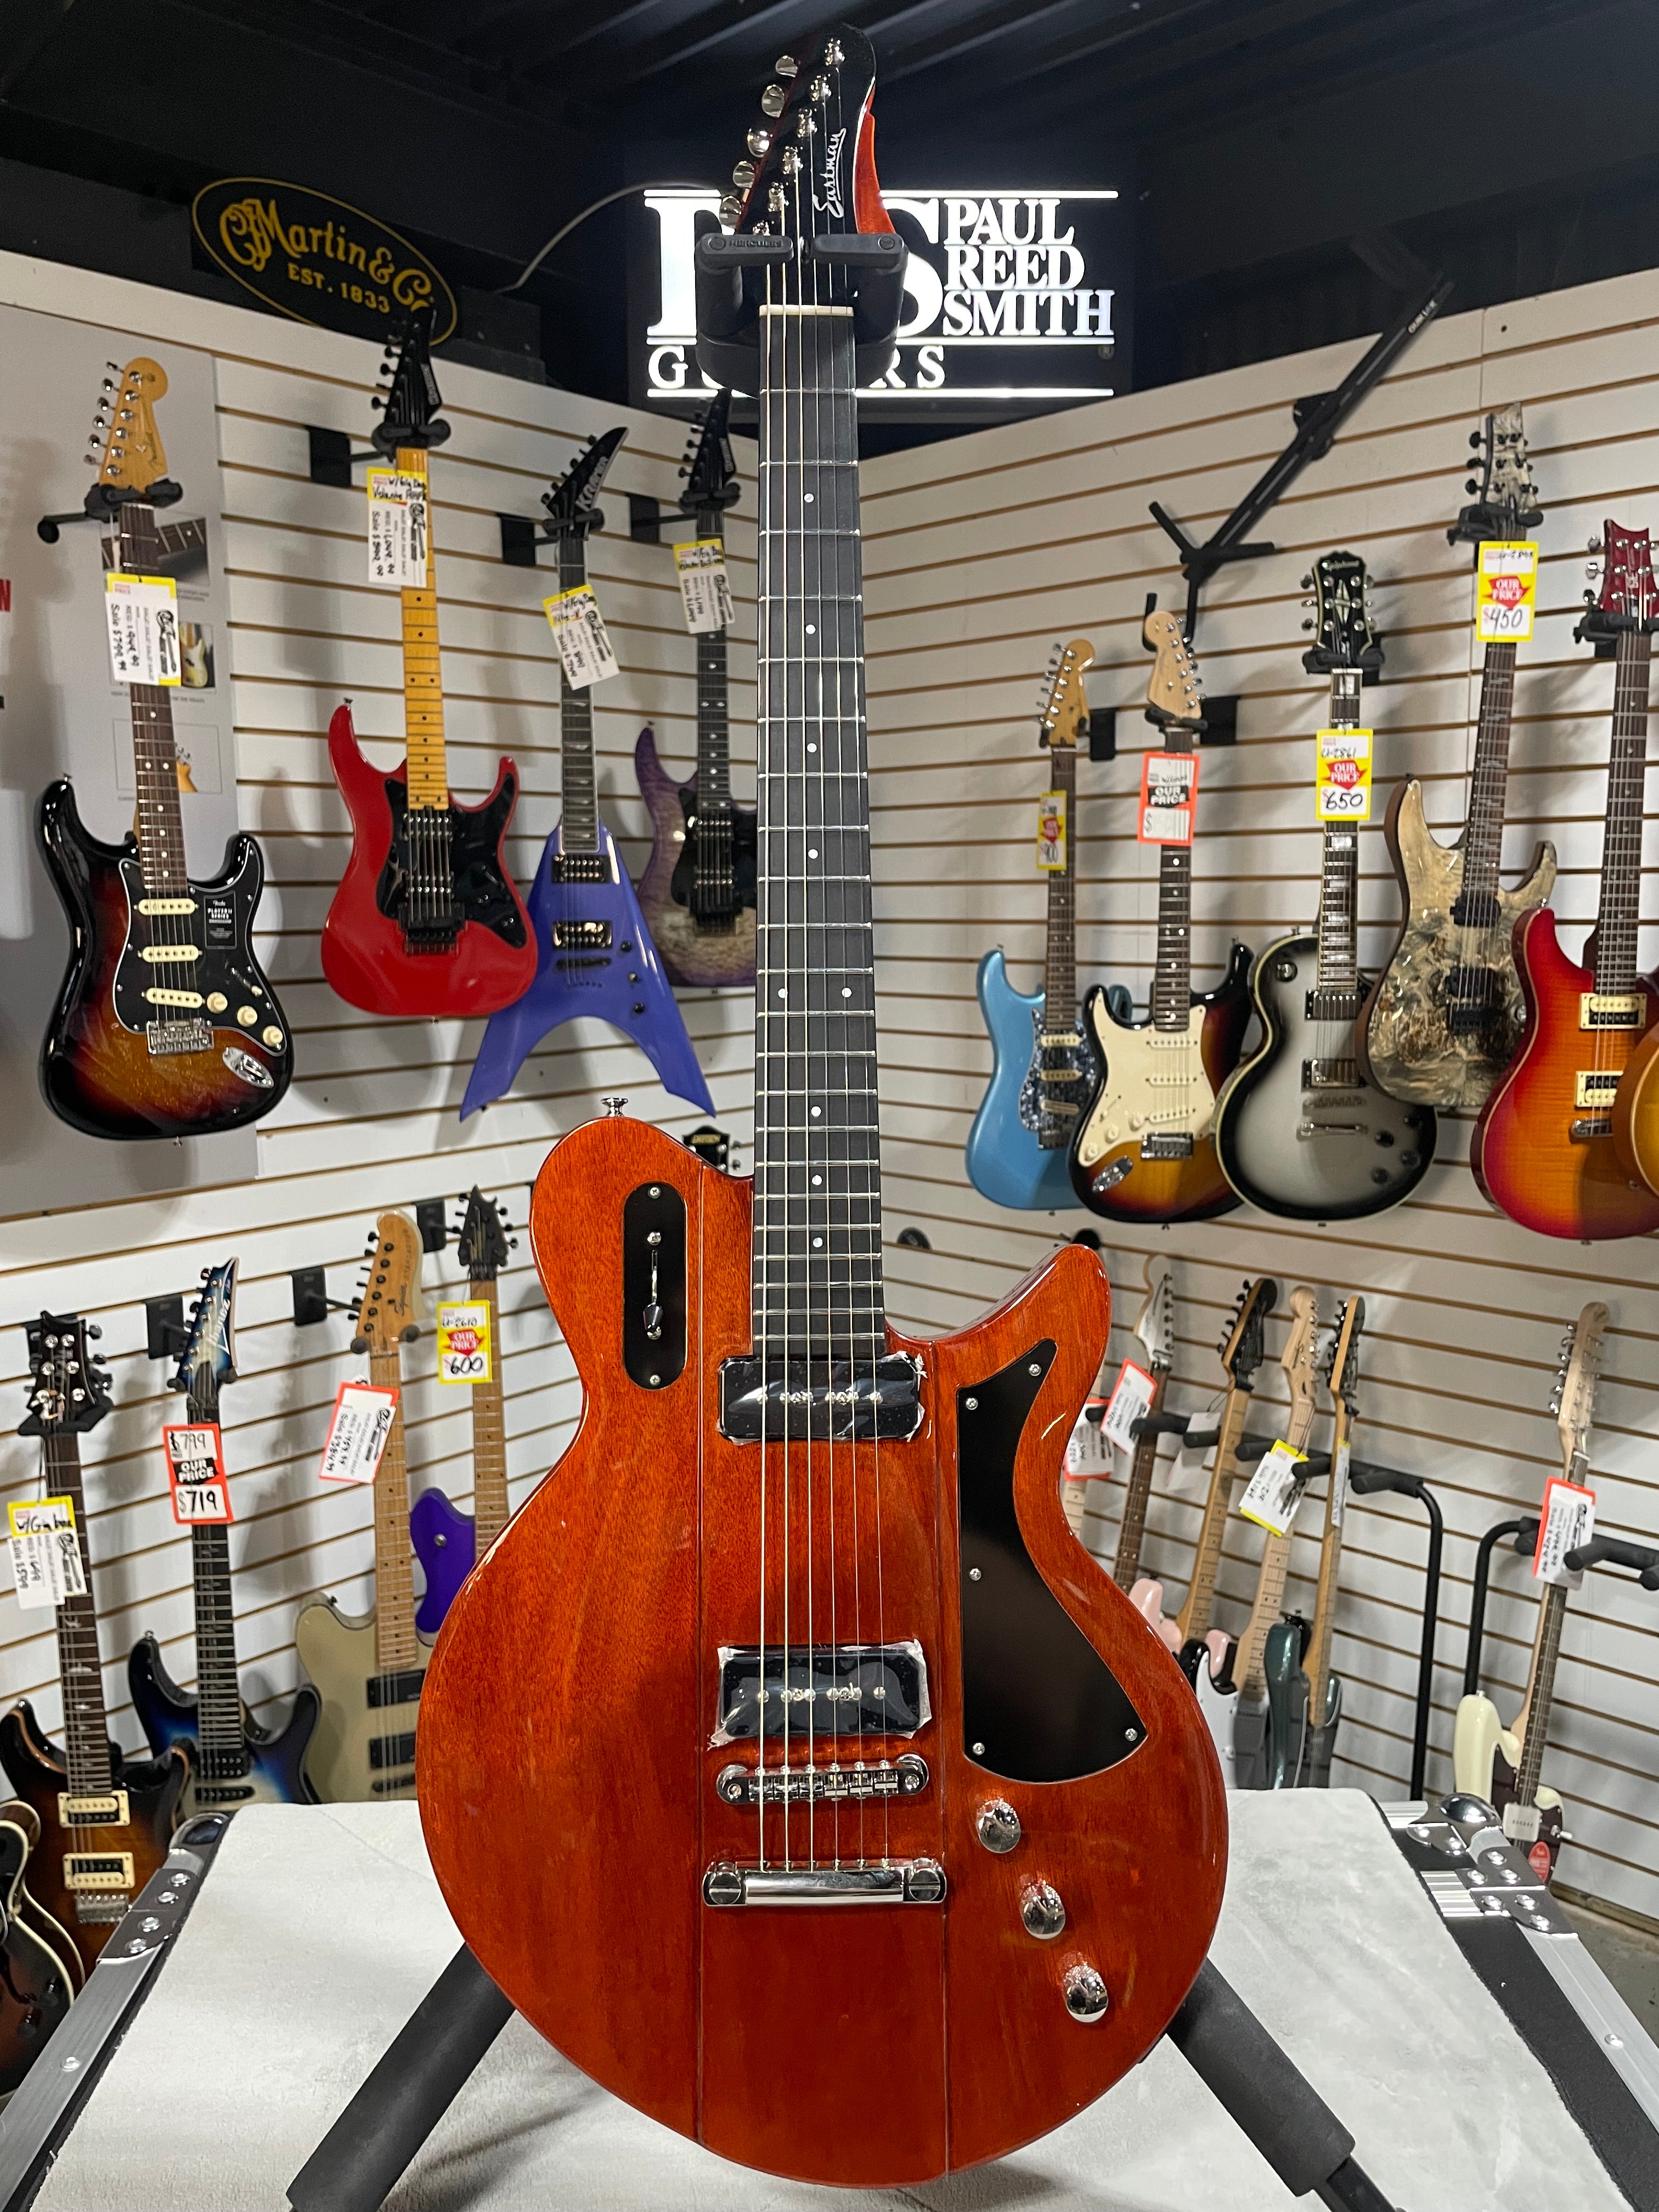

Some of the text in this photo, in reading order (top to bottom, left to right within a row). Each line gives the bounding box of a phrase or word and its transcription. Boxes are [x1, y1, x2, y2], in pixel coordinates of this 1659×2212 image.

[812, 128, 846, 218] Eastman
[945, 198, 1074, 245] PAUL
[945, 245, 1085, 290] REED
[943, 290, 1115, 336] SMITH
[1496, 579, 1520, 589] OUR
[1492, 589, 1523, 601] PRICE
[1334, 763, 1356, 772] OUR
[1331, 772, 1360, 783] PRICE
[1154, 786, 1181, 796] OUR
[1150, 795, 1187, 805] PRICE
[454, 1331, 475, 1341] OUR
[451, 1340, 479, 1350] PRICE
[180, 1459, 207, 1471] OUR
[178, 1468, 215, 1482] PRICE
[178, 1490, 218, 1513] $719
